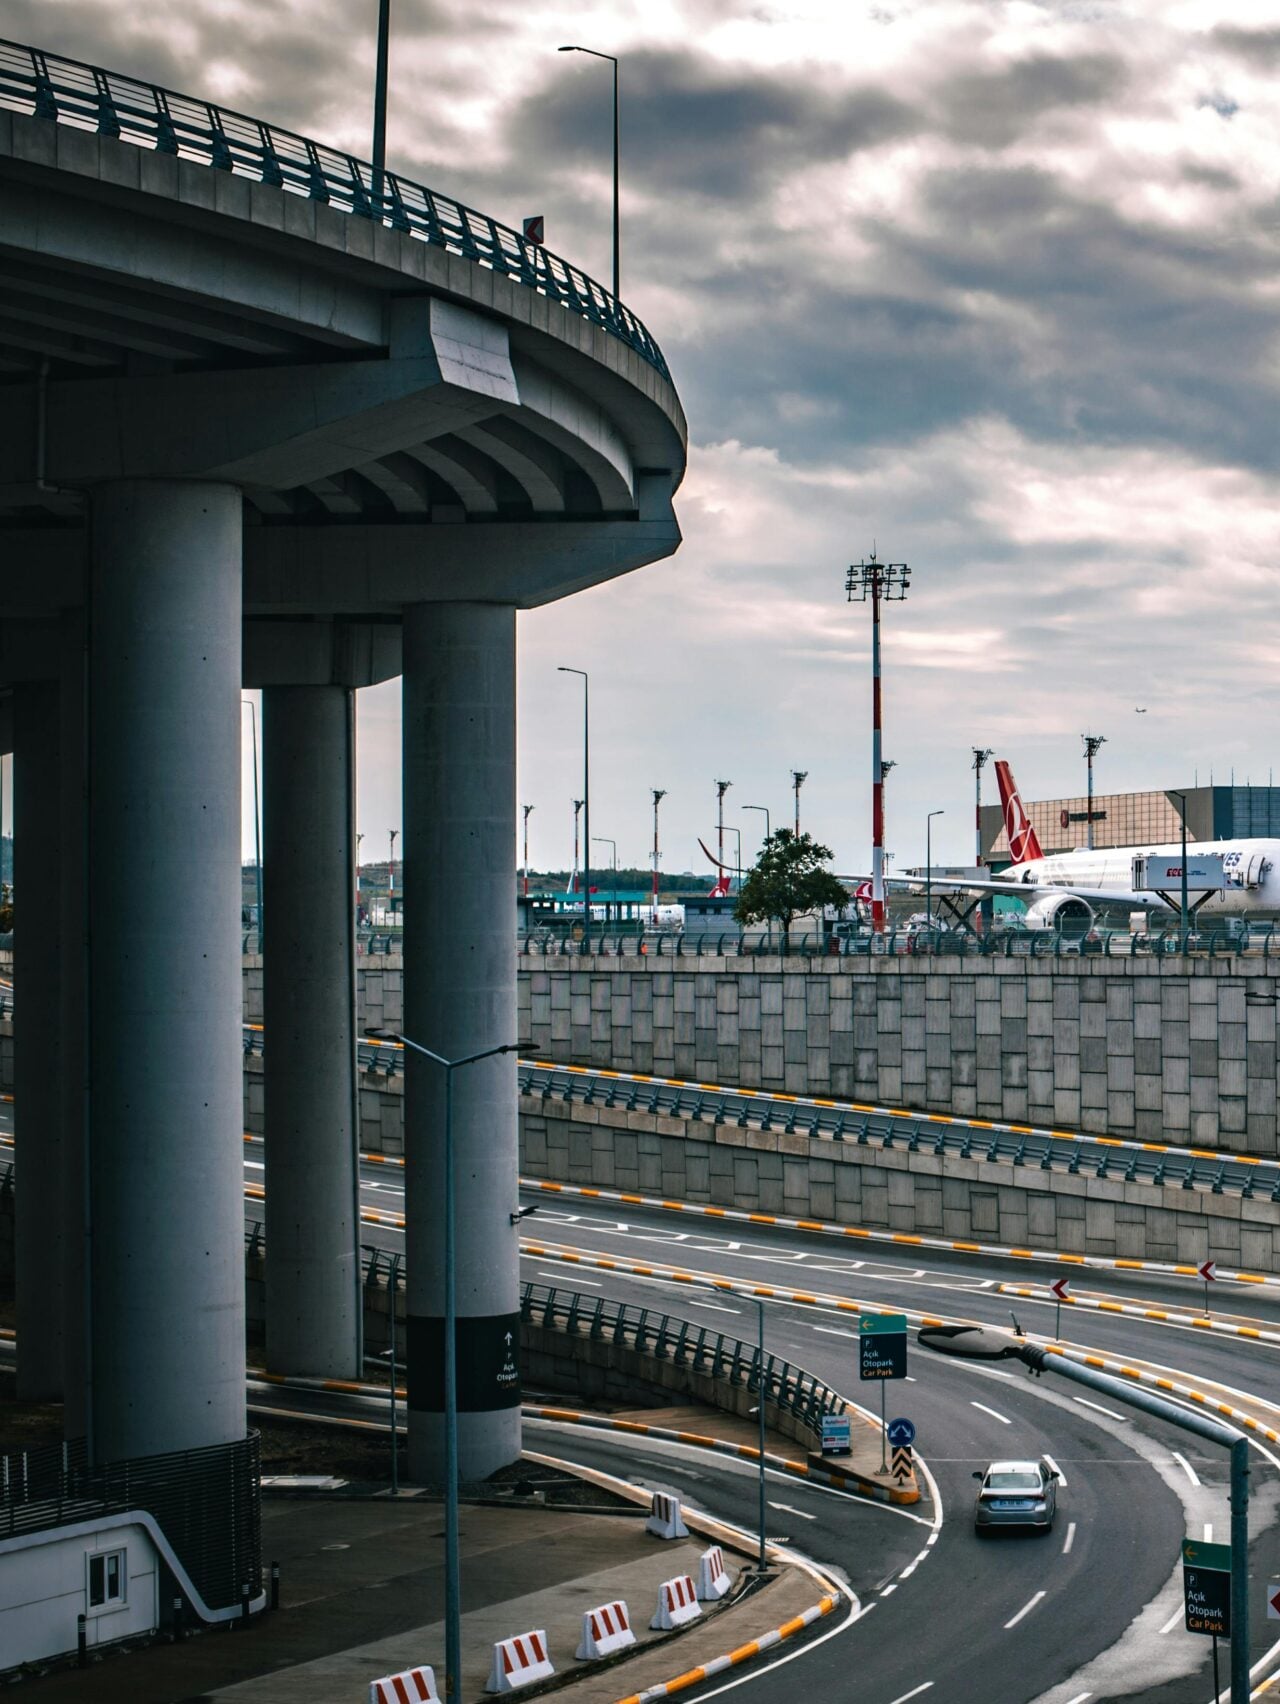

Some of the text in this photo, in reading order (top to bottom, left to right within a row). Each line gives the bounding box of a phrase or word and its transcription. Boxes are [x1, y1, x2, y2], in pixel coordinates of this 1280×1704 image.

[863, 1349, 879, 1359] Açık
[863, 1358, 893, 1368] Otopark
[863, 1367, 893, 1377] Car Park
[1188, 1590, 1205, 1602] Açık
[1188, 1604, 1223, 1618] Otopark
[1189, 1618, 1223, 1631] Car Park
